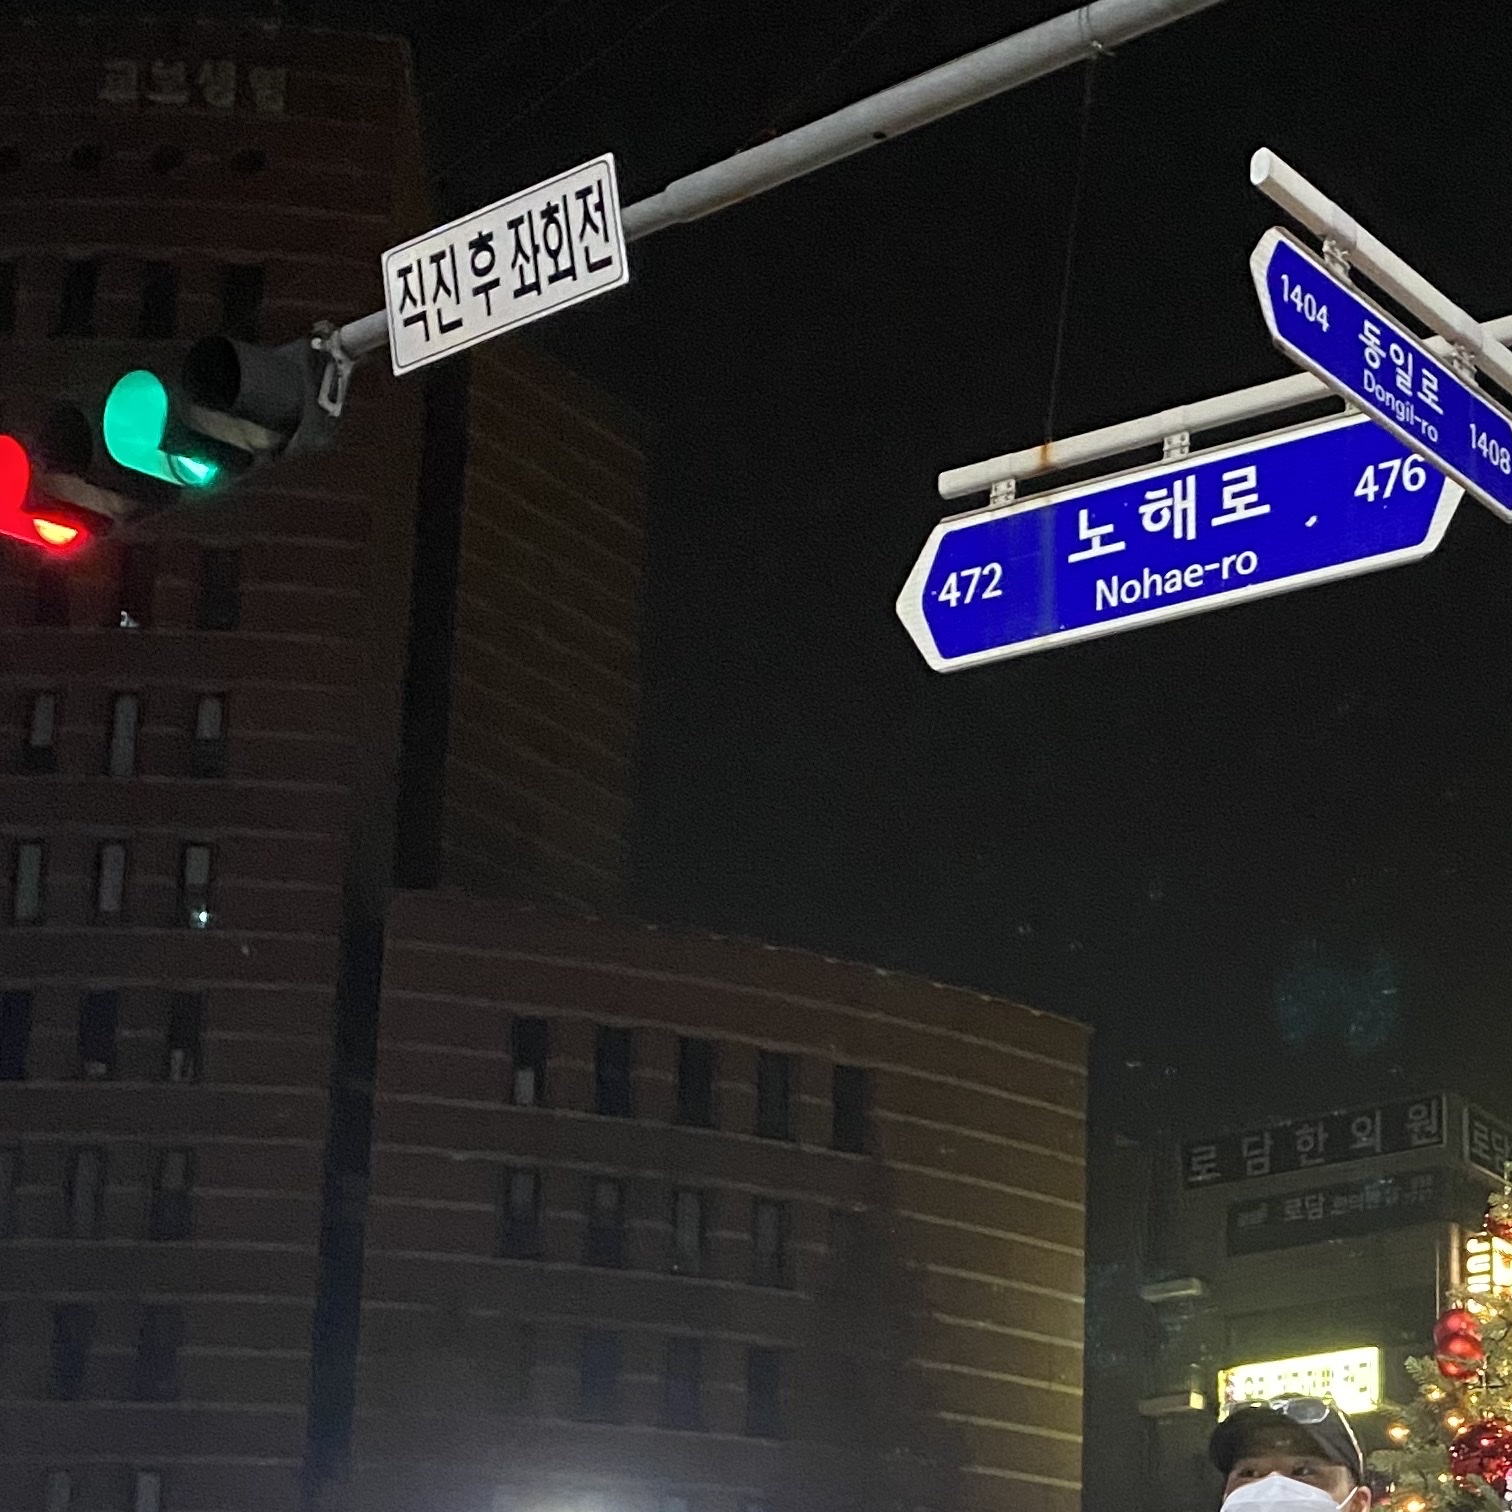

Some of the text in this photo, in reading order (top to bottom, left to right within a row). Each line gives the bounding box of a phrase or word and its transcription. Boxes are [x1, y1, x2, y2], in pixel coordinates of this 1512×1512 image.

[397, 180, 613, 342] 직진 후 좌회전
[1280, 273, 1330, 332] 1404
[1356, 318, 1444, 415] 동일로
[1362, 367, 1440, 444] Dongil-ro
[1354, 453, 1427, 503] 476
[1468, 422, 1512, 475] 1408
[1067, 465, 1272, 563] 노해로
[937, 562, 1003, 607] 472
[1094, 549, 1258, 612] Nohae-ro
[1187, 1101, 1440, 1182] 로담한의원
